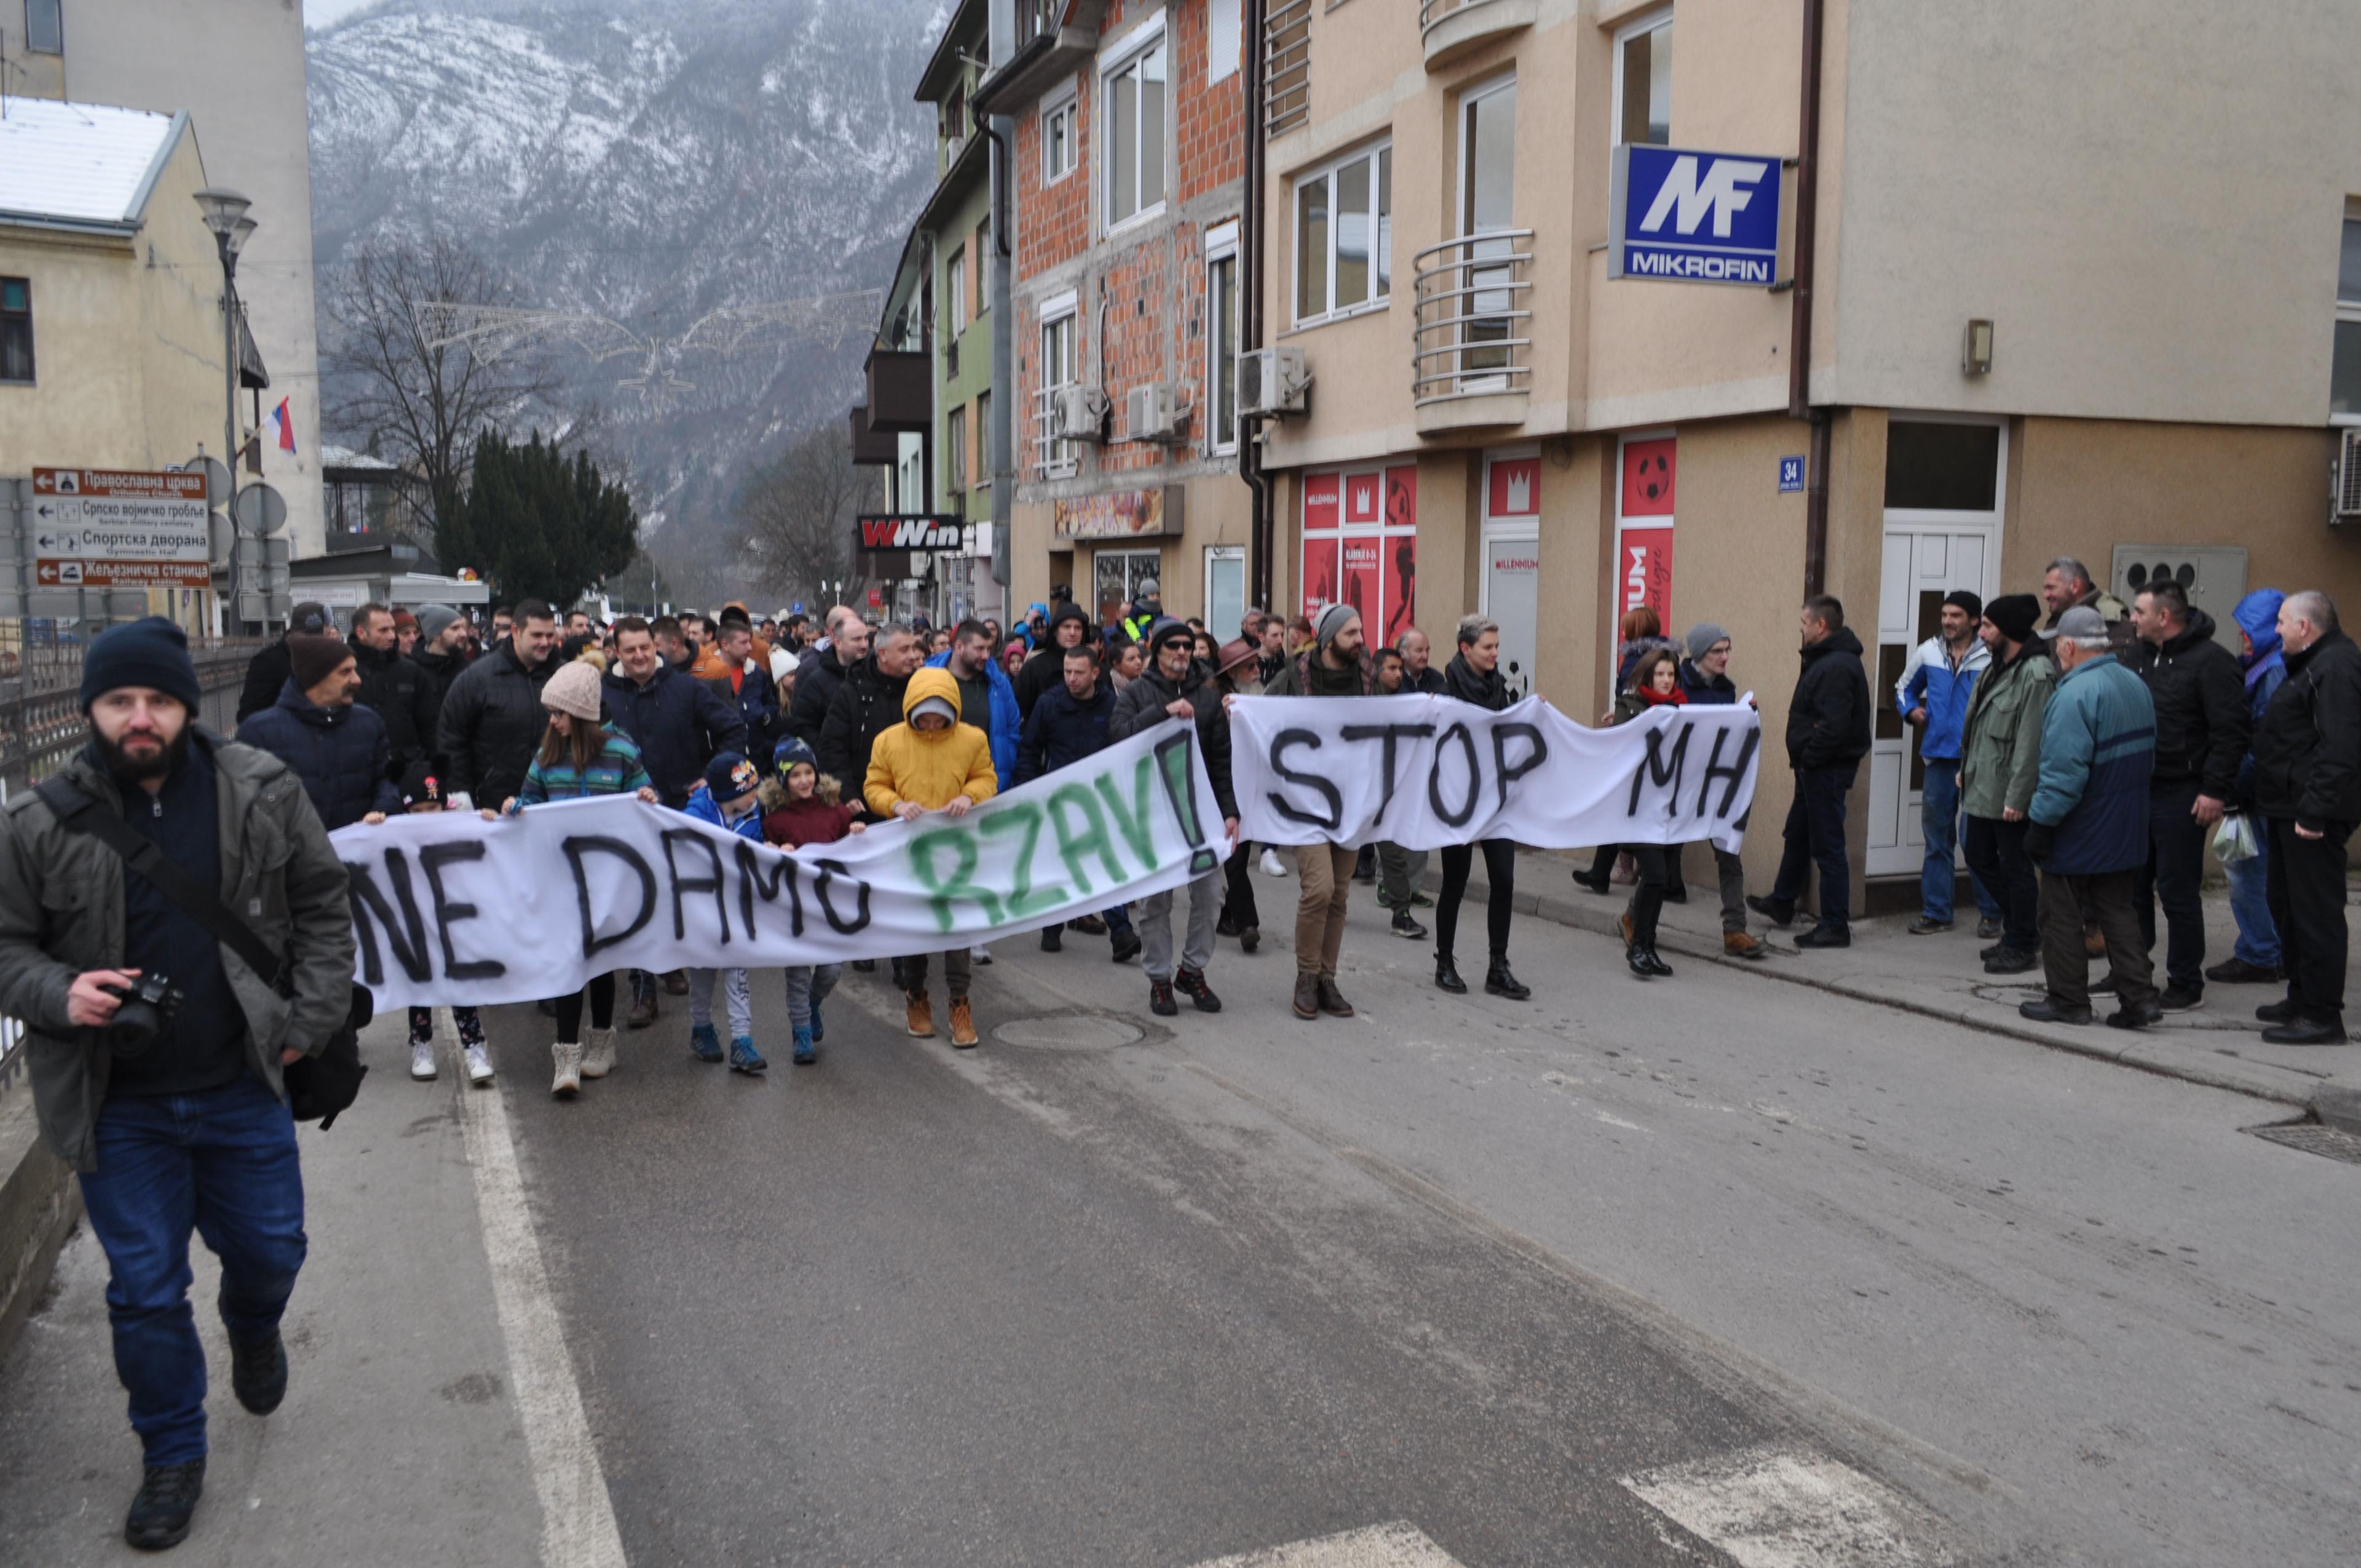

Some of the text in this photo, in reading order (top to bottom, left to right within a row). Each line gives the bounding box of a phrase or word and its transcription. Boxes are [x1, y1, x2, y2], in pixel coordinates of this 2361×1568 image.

[1639, 155, 1768, 238] MF
[1632, 251, 1768, 282] MIKROFIN
[85, 470, 200, 491] Православна црква
[1785, 462, 1797, 481] 34
[83, 499, 205, 519] Српско војничко гробље
[1308, 493, 1337, 505] MILLENNIUM
[82, 529, 207, 548] Спортска дворана
[862, 519, 959, 547] WWin
[85, 560, 208, 580] Жељезничка станица
[1495, 558, 1539, 571] MILLENNIUM
[1267, 721, 1548, 831] STOP
[344, 728, 1218, 985] NE DAMO RZAV!
